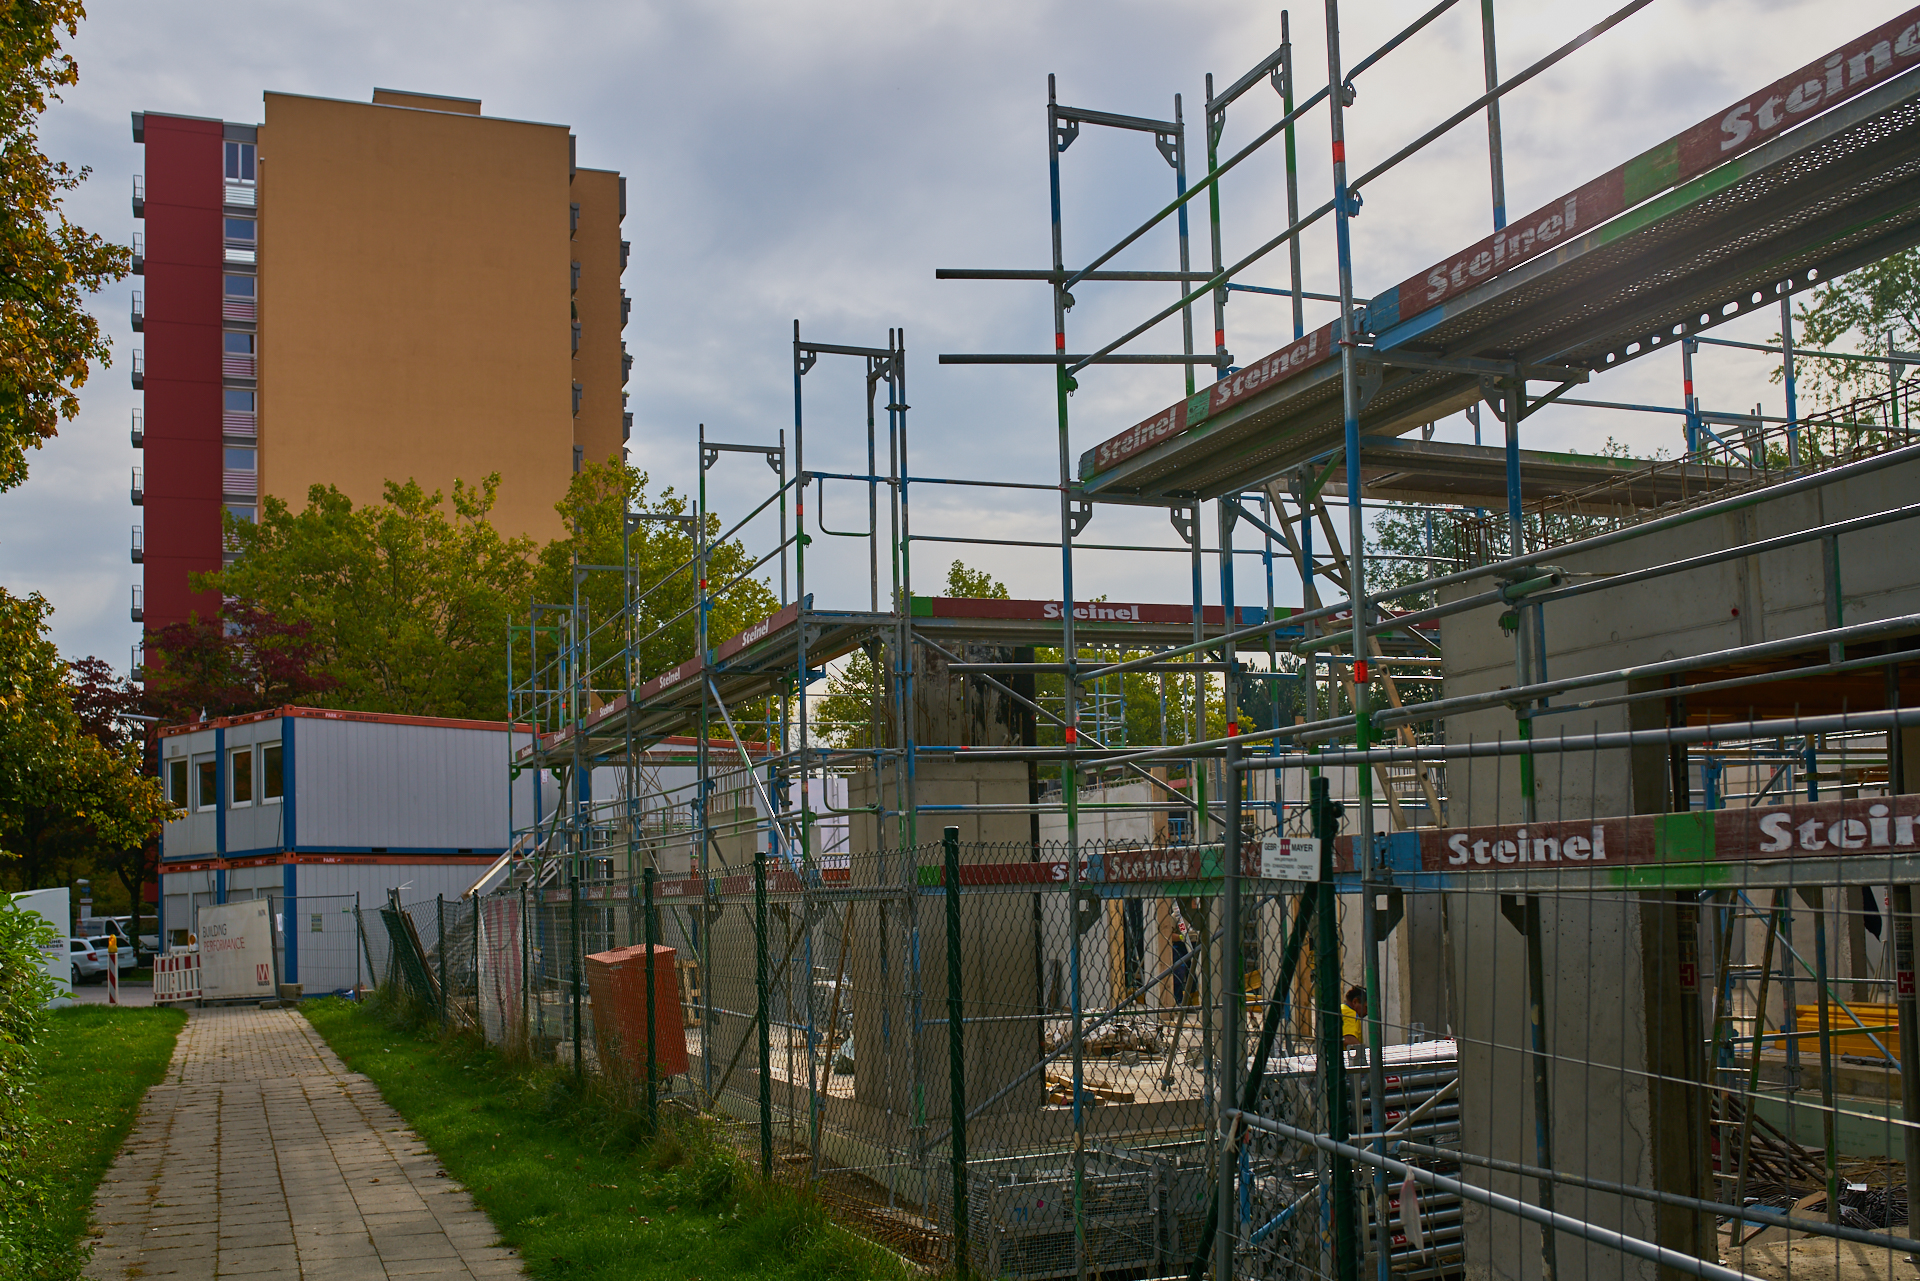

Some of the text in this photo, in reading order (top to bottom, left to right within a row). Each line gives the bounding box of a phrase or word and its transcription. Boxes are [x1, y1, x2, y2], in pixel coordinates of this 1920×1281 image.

[1427, 195, 1578, 301] Steinel
[1215, 331, 1318, 406] Steinel
[1098, 406, 1176, 467] Steinel
[741, 618, 770, 647] Steinel
[659, 666, 681, 689] Steinel
[1291, 843, 1313, 852] MAYER
[1448, 824, 1607, 865] Steinel
[1109, 850, 1190, 880] Steinel
[202, 923, 227, 938] BUILDING
[203, 936, 246, 953] PERFORMANCE
